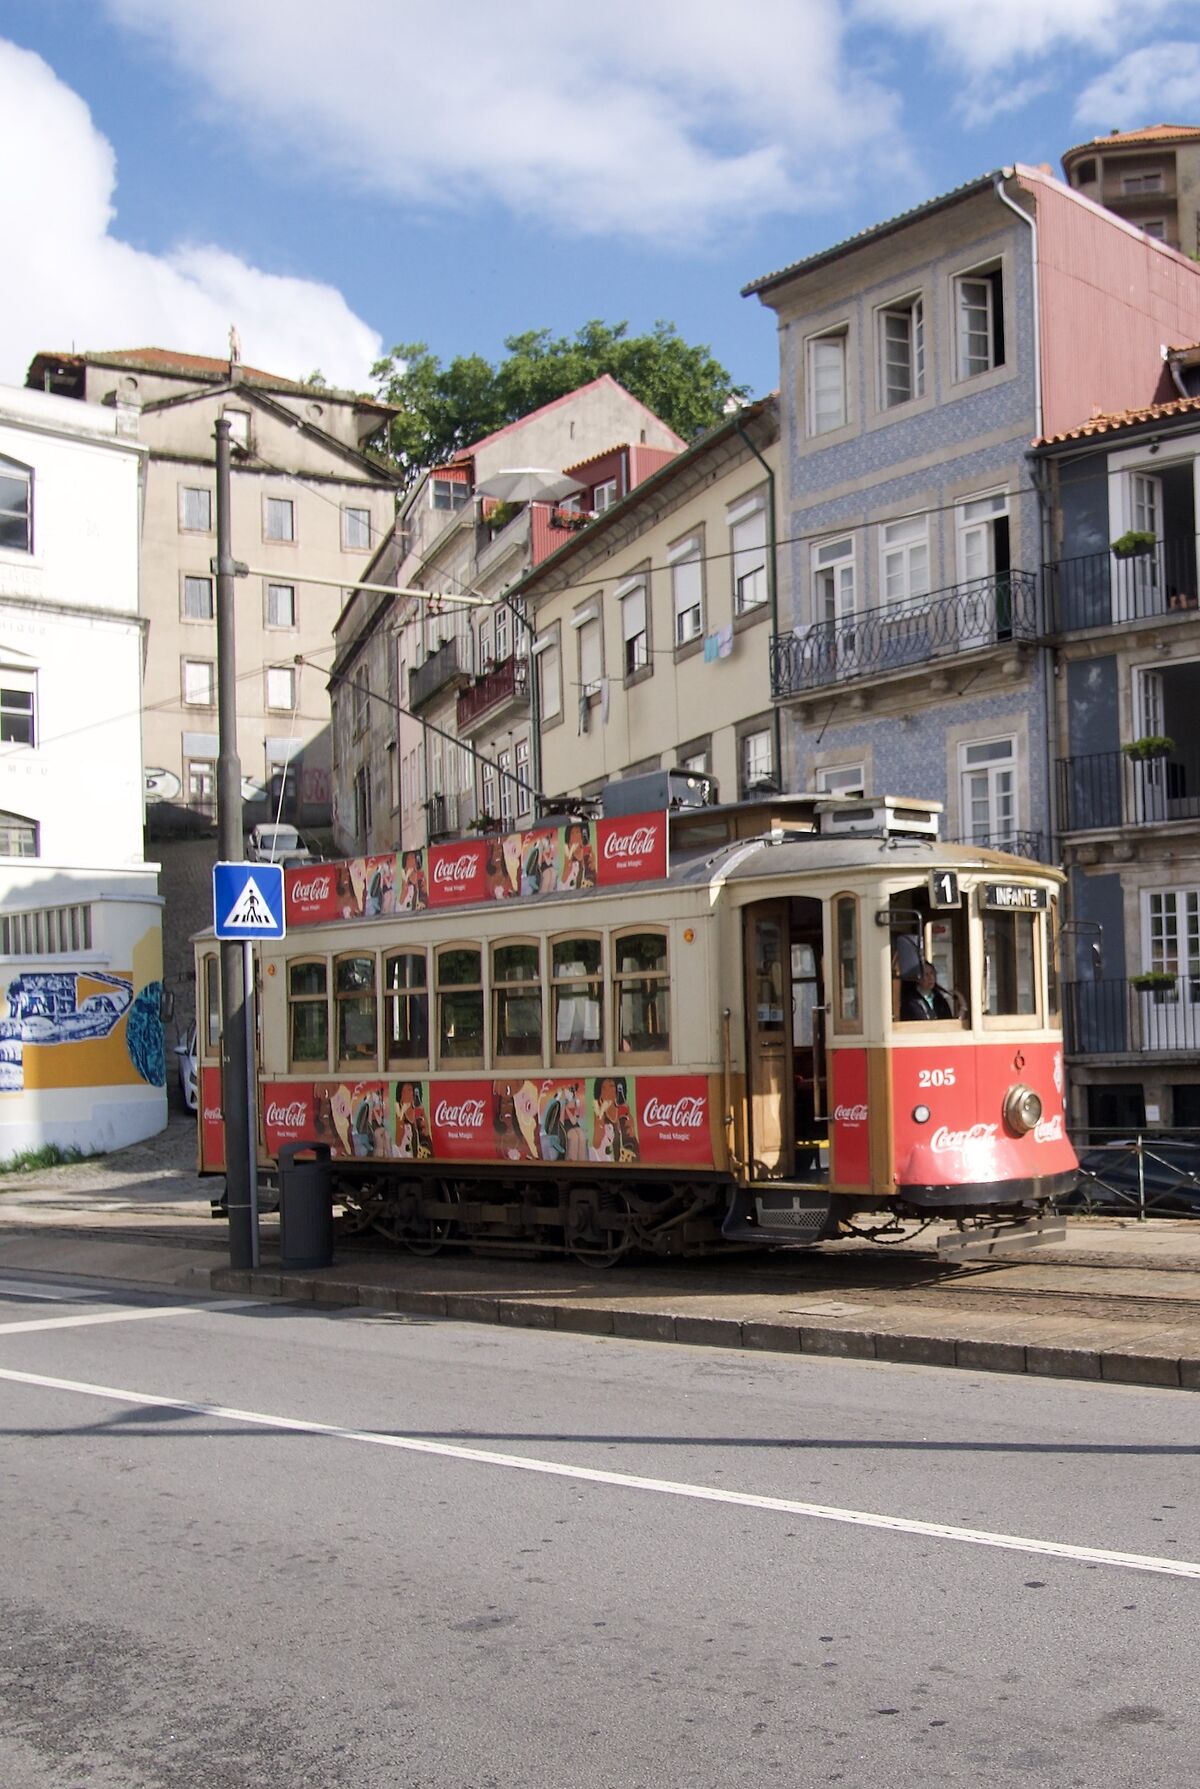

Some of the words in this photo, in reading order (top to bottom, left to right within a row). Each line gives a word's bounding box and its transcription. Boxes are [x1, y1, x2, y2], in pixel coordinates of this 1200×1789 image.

[603, 826, 658, 859] Coca-Cola
[433, 853, 480, 884] Coca-Cola
[291, 876, 331, 904] Coca-Cola
[940, 874, 952, 903] 1
[995, 886, 1038, 908] INFANTE
[918, 1067, 956, 1088] 205
[266, 1101, 308, 1127] Coca-Cola
[435, 1099, 486, 1128] Coca-Cola
[642, 1096, 707, 1128] Coca-Cola
